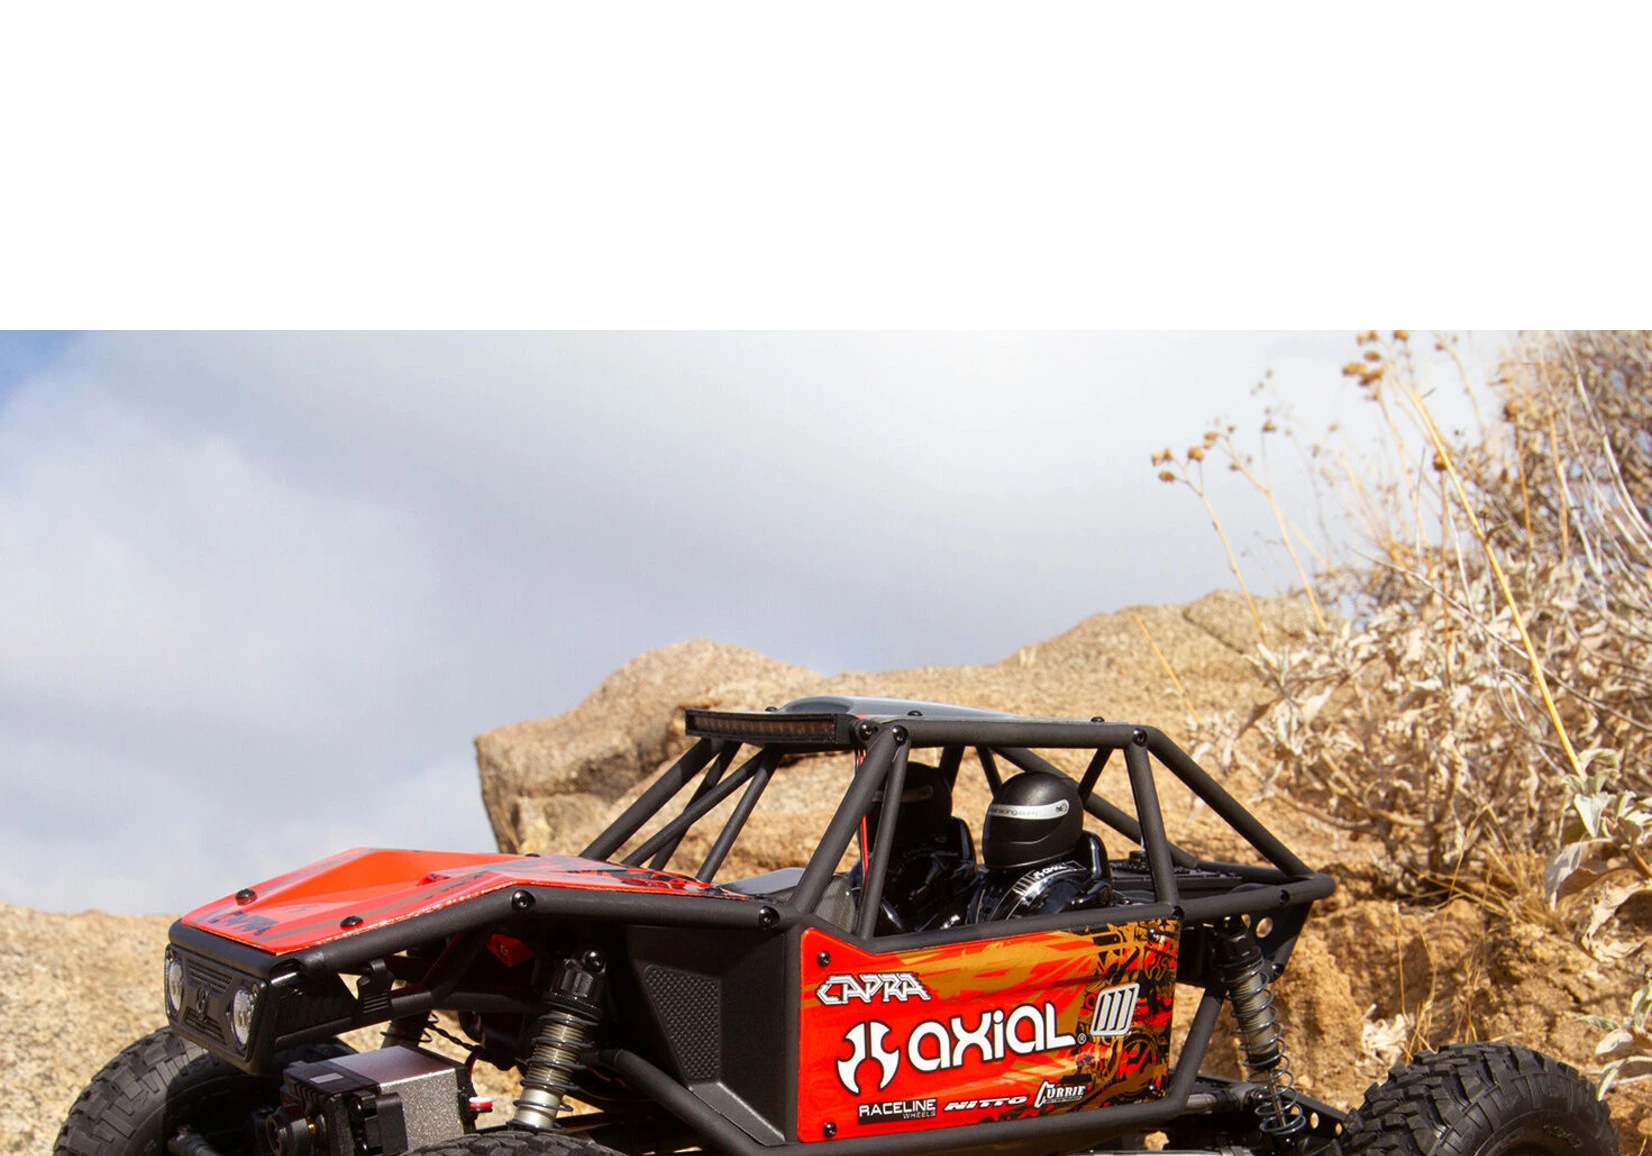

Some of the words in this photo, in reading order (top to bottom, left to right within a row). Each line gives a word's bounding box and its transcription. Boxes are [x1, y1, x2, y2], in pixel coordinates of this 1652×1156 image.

[816, 971, 931, 1005] CAPRA
[1034, 1080, 1086, 1108] CURRIE
[858, 1099, 936, 1117] RACELINE
[943, 1096, 1028, 1111] NITTO
[903, 1110, 936, 1120] WHEELS
